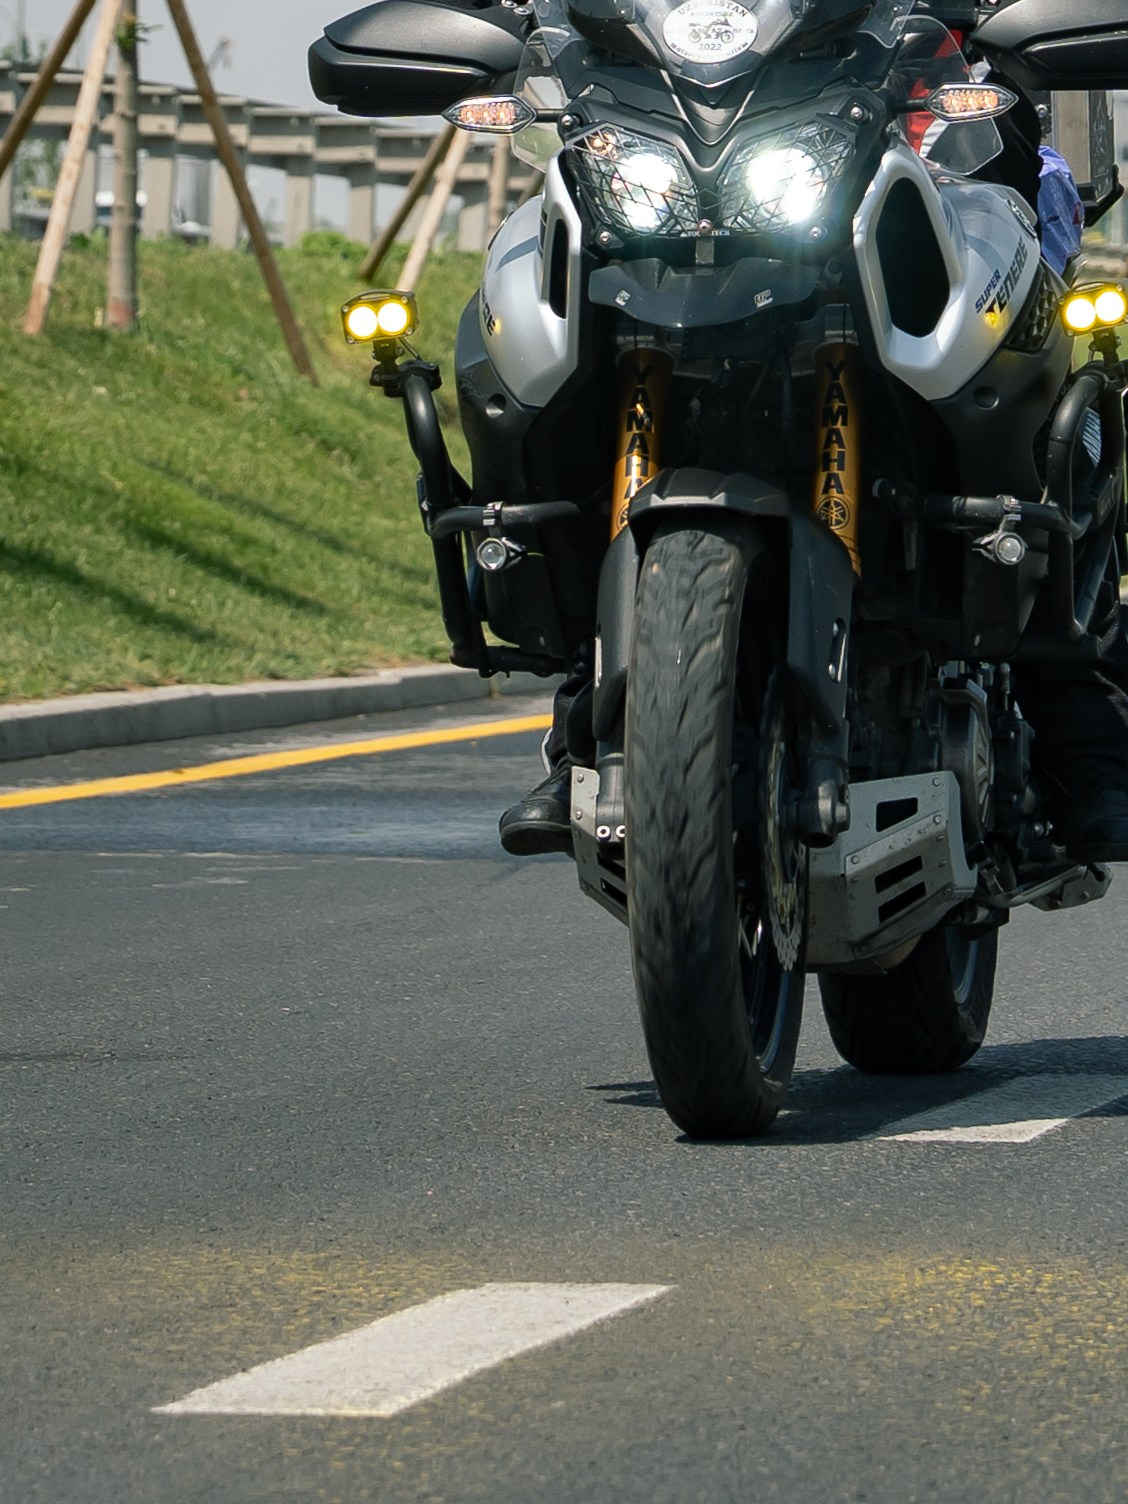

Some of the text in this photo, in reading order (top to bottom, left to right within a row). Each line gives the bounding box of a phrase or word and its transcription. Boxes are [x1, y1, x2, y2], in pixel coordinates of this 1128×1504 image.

[698, 42, 722, 51] 2022
[975, 267, 1002, 314] SUPER
[821, 359, 849, 496] YAMAHA
